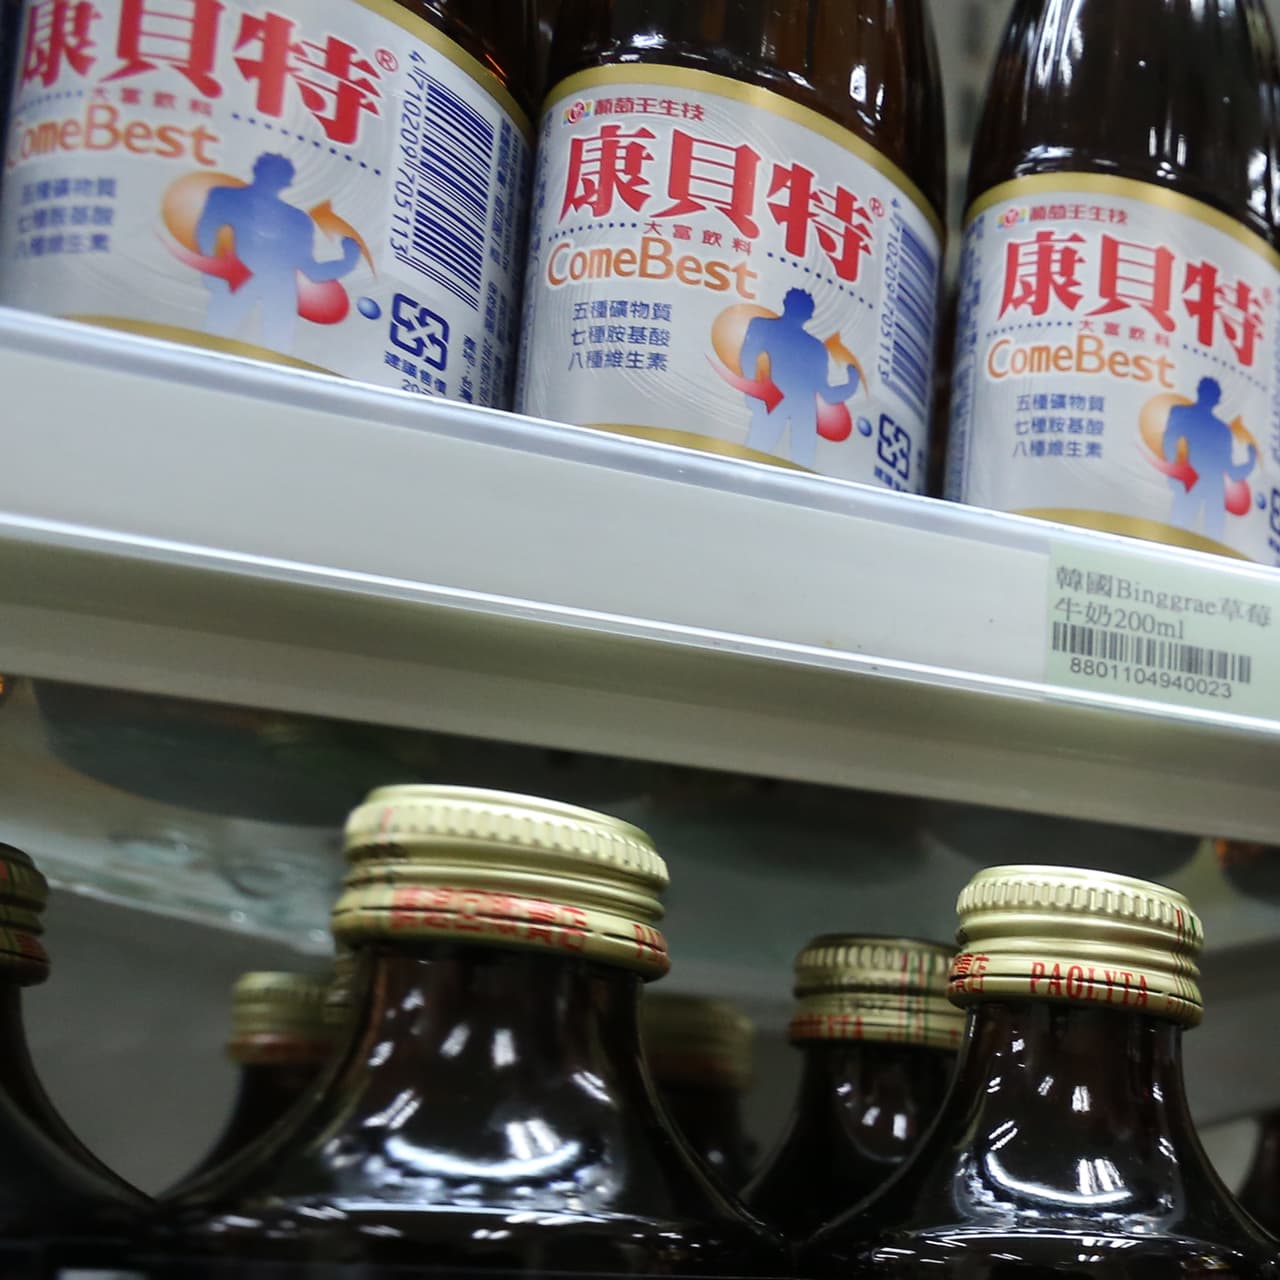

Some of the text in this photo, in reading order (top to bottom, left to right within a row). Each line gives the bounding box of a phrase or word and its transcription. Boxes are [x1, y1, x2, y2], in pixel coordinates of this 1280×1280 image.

[559, 125, 873, 282] 康貝特
[547, 235, 757, 301] ComeBest
[572, 301, 672, 323] 五種礦物質
[998, 231, 1265, 367] 康貝特
[571, 326, 670, 348] 七種胺基酸
[568, 350, 668, 373] 八種維生素
[987, 334, 1177, 390] ComeBest
[1054, 597, 1186, 641] 牛奶200ml
[1069, 657, 1234, 700] 8801104940023
